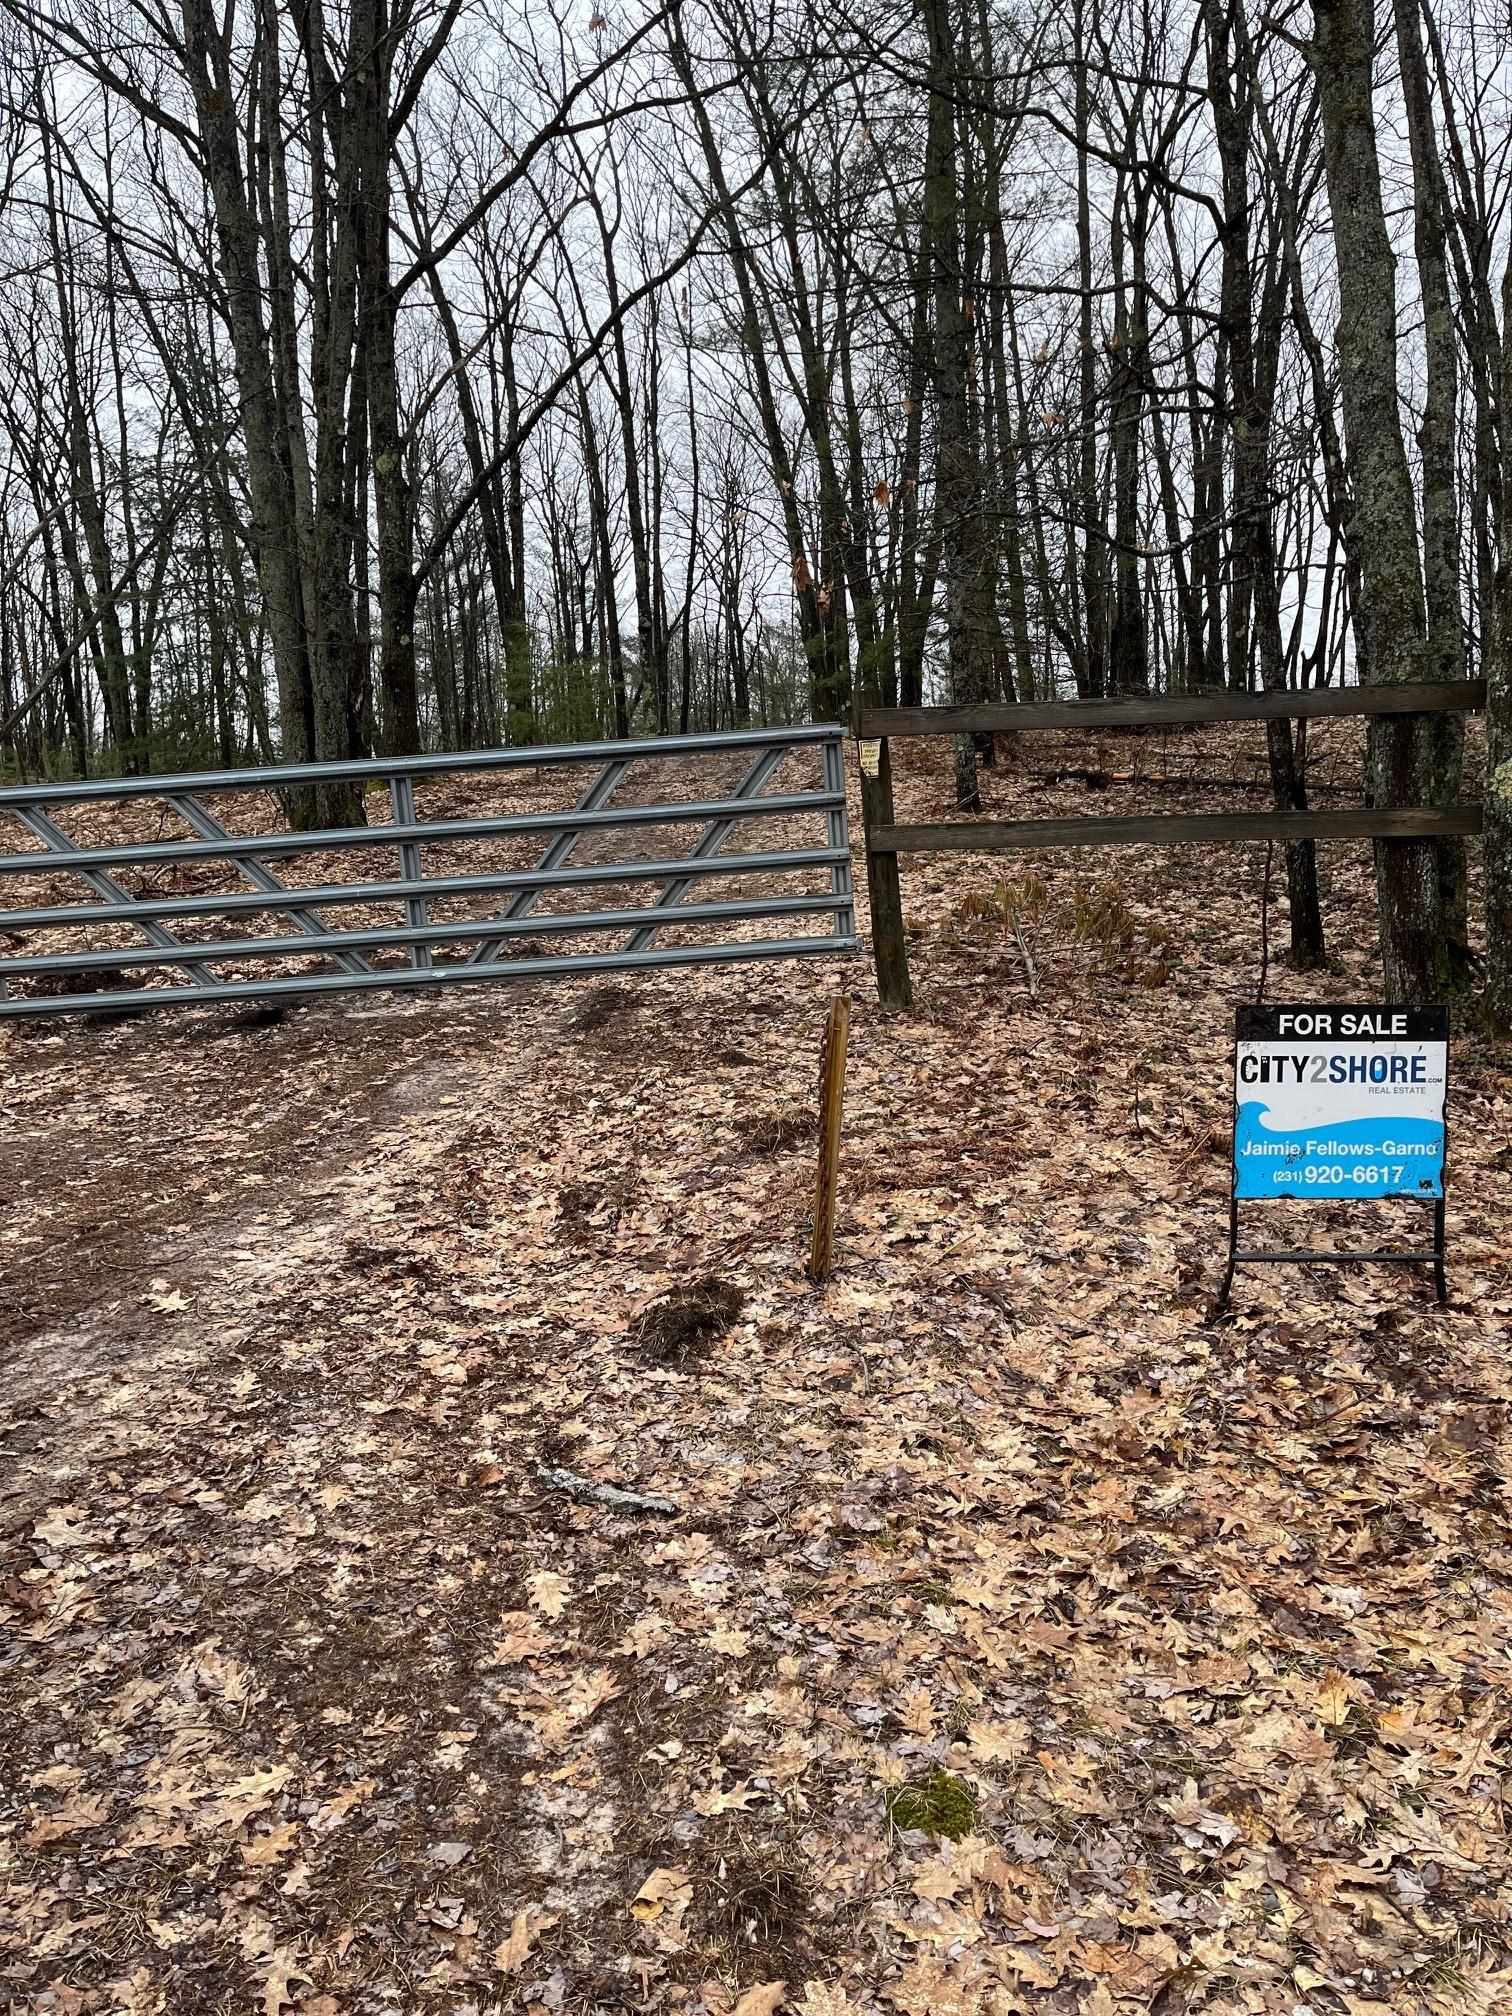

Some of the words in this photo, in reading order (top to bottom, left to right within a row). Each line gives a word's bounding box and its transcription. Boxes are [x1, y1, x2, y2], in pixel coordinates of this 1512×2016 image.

[1279, 1014, 1332, 1035] FOR
[1340, 1014, 1408, 1035] SALE
[1368, 1087, 1391, 1095] REAL
[1393, 1087, 1427, 1095] ESTATE
[1242, 1140, 1301, 1156] Jaimie
[1272, 1170, 1303, 1183] (231)
[1304, 1165, 1405, 1184] 920-6617
